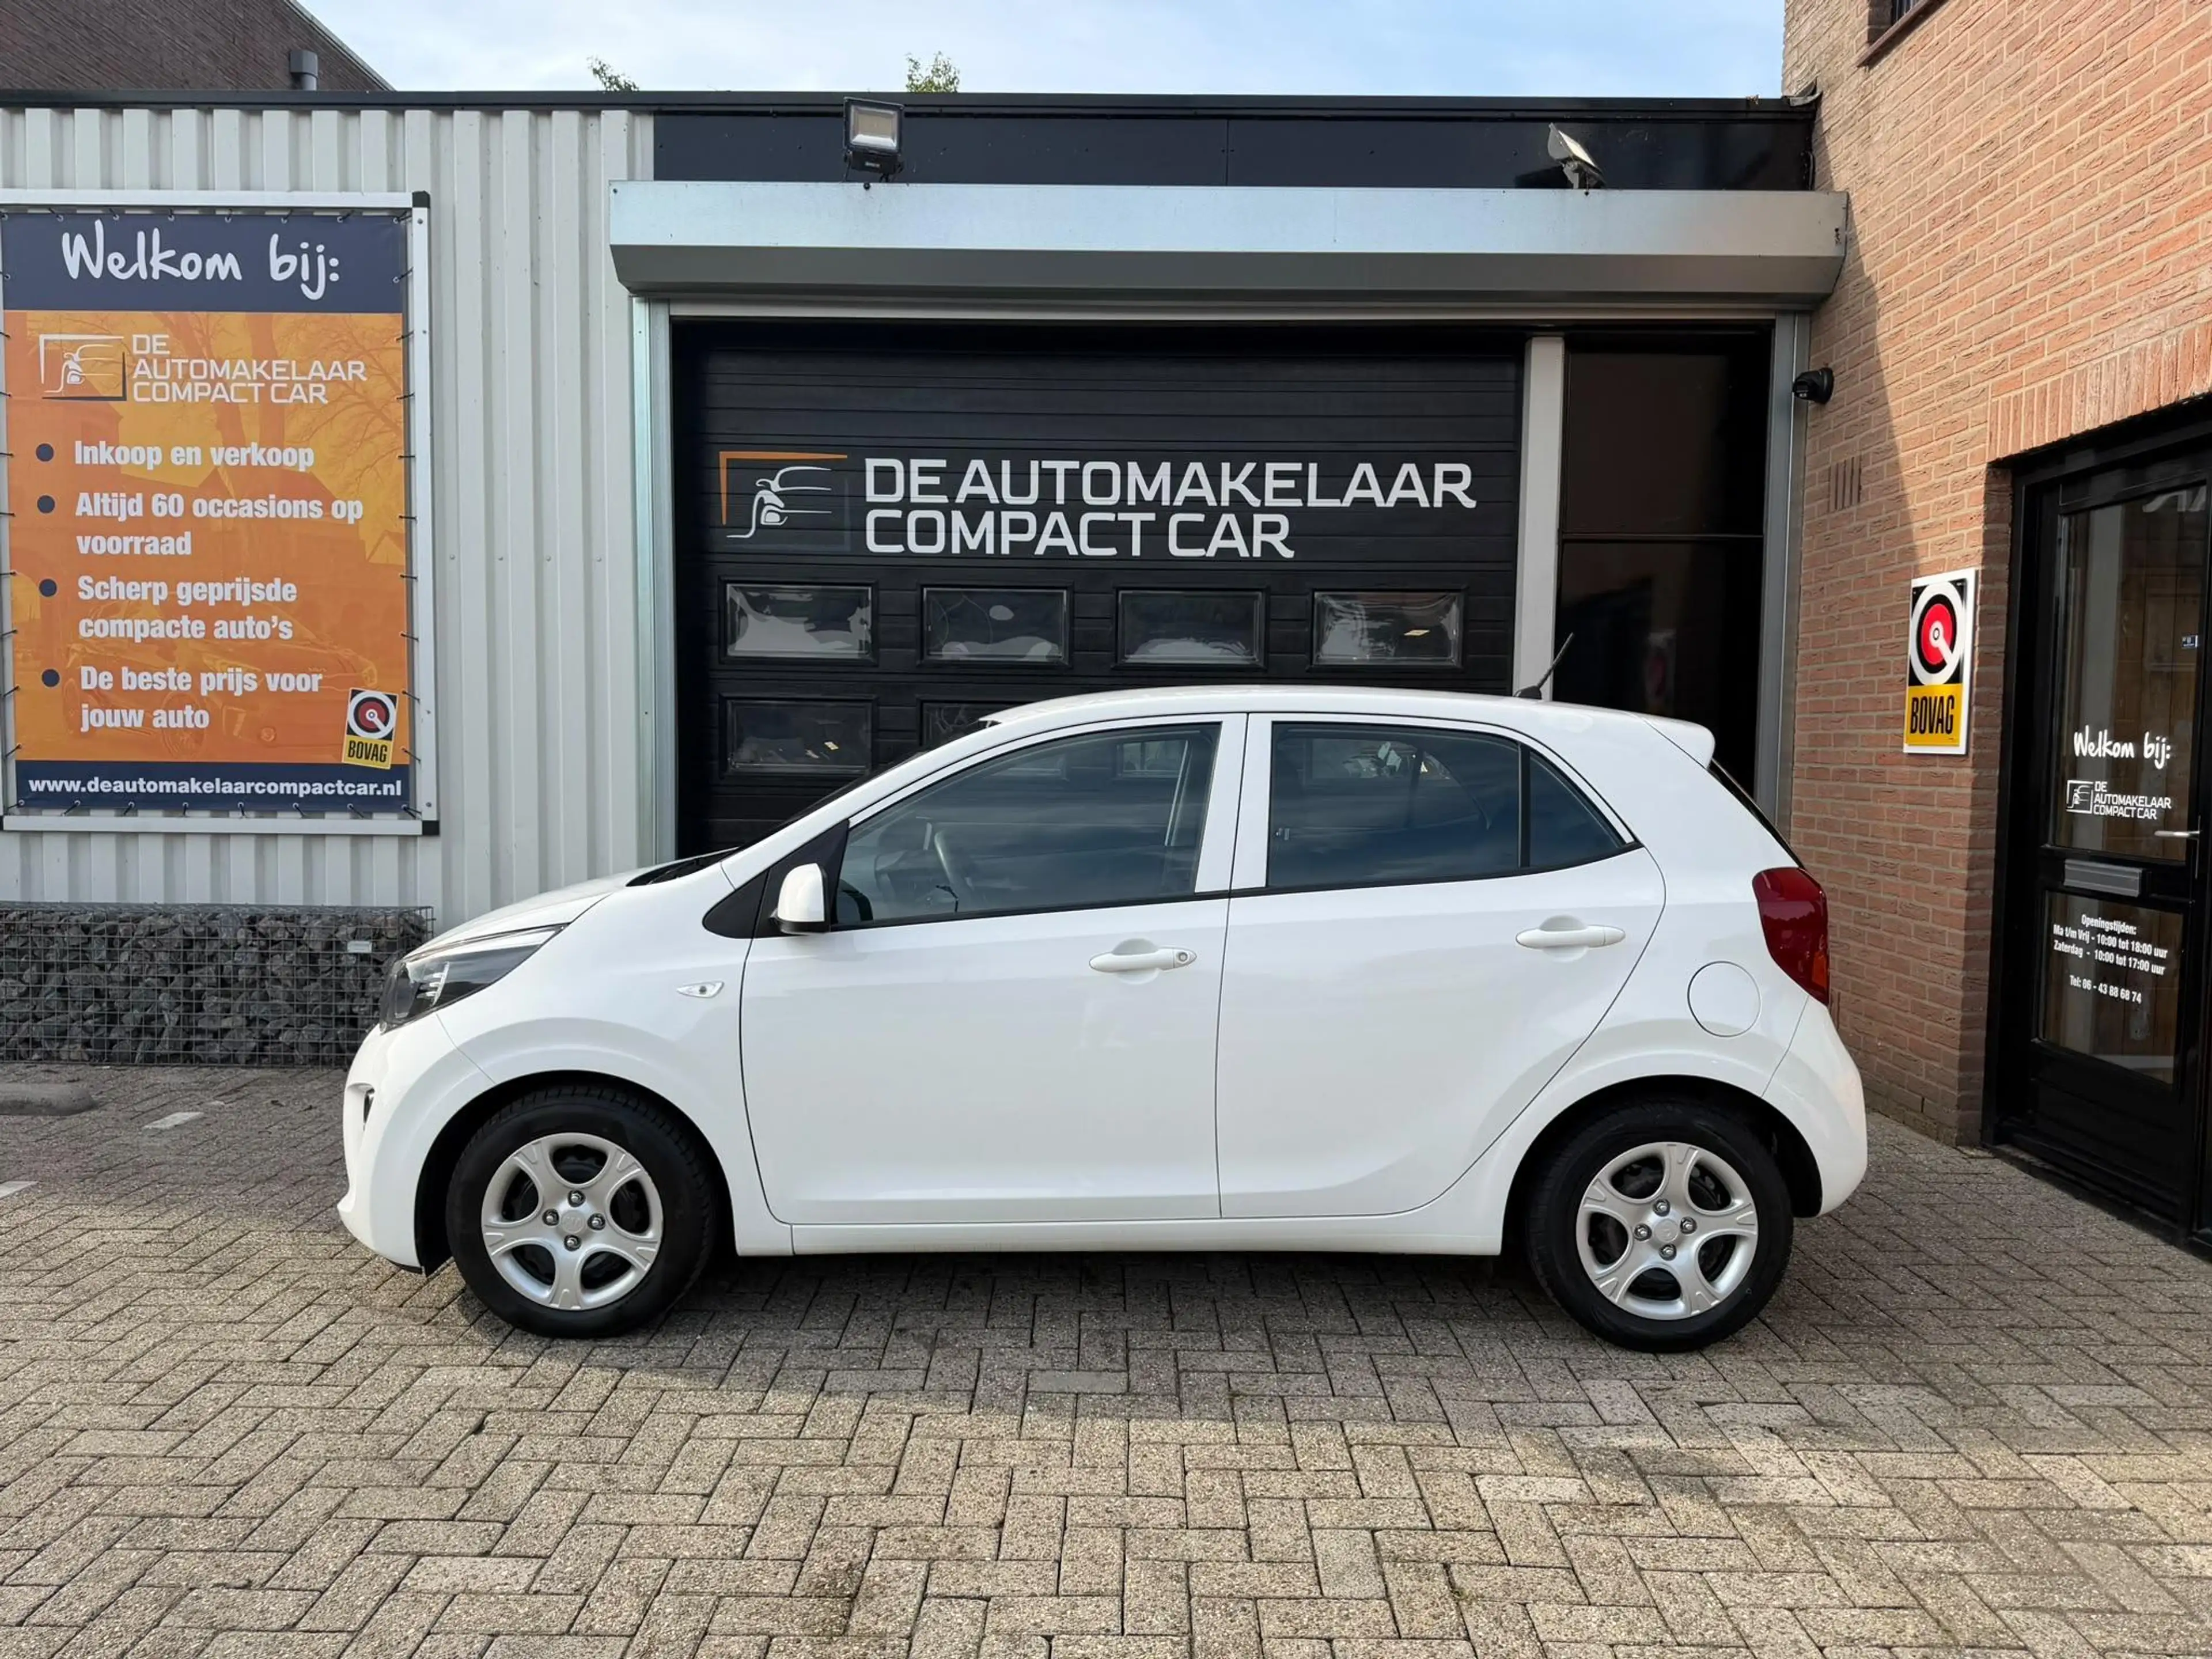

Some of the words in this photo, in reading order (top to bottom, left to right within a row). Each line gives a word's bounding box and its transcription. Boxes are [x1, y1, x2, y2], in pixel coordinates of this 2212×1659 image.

[62, 219, 242, 280] Welkom
[270, 234, 339, 300] bij:
[132, 334, 169, 354] DE
[133, 358, 367, 381] AUTOMAKELAAR
[133, 382, 262, 403] COMPACT
[271, 383, 328, 404] CAR
[75, 441, 162, 470] Inkoop
[171, 446, 202, 465] en
[210, 442, 314, 472] verkoop
[865, 459, 949, 503] DE
[955, 460, 1476, 508] AUTOMAKELAAR
[76, 493, 143, 521] Altijd
[152, 494, 184, 517] 60
[193, 494, 323, 518] occasions
[332, 500, 363, 524] op
[77, 532, 191, 555] voorraad
[865, 510, 1156, 556] COMPACT
[1169, 513, 1294, 558] CAR
[78, 575, 168, 605] Scherp
[176, 577, 297, 606] geprijsde
[79, 615, 205, 643] compacte
[214, 616, 293, 639] auto's
[81, 666, 113, 690] De
[122, 666, 191, 691] beste
[200, 668, 257, 696] prijs
[266, 673, 323, 692] voor
[81, 704, 144, 732] jouw
[153, 705, 209, 728] auto
[1910, 695, 1955, 734] BOVAG
[347, 740, 388, 763] BOVAG
[2074, 725, 2134, 757] Welkom
[2144, 732, 2171, 769] bij:
[29, 777, 401, 797] www.deautomakelaarcompactcar.nl
[2094, 781, 2107, 792] DE
[2093, 805, 2137, 818] COMPACT
[2137, 808, 2157, 819] CAR
[2094, 793, 2172, 809] AUTOMAKELAAR
[2081, 914, 2137, 935] Openingstijden:
[2054, 940, 2083, 958] Zaterdag
[2094, 949, 2114, 963] 10:00
[2116, 954, 2126, 966] tot
[2128, 957, 2150, 972] 17:00
[2152, 964, 2165, 975] uur
[2078, 929, 2089, 944] Vrij
[2097, 933, 2117, 947] 10:00
[2119, 938, 2129, 950] tot
[2131, 941, 2152, 955] 18:00
[2154, 948, 2168, 958] uur
[2098, 983, 2107, 994] 43
[2132, 991, 2141, 1003] 74
